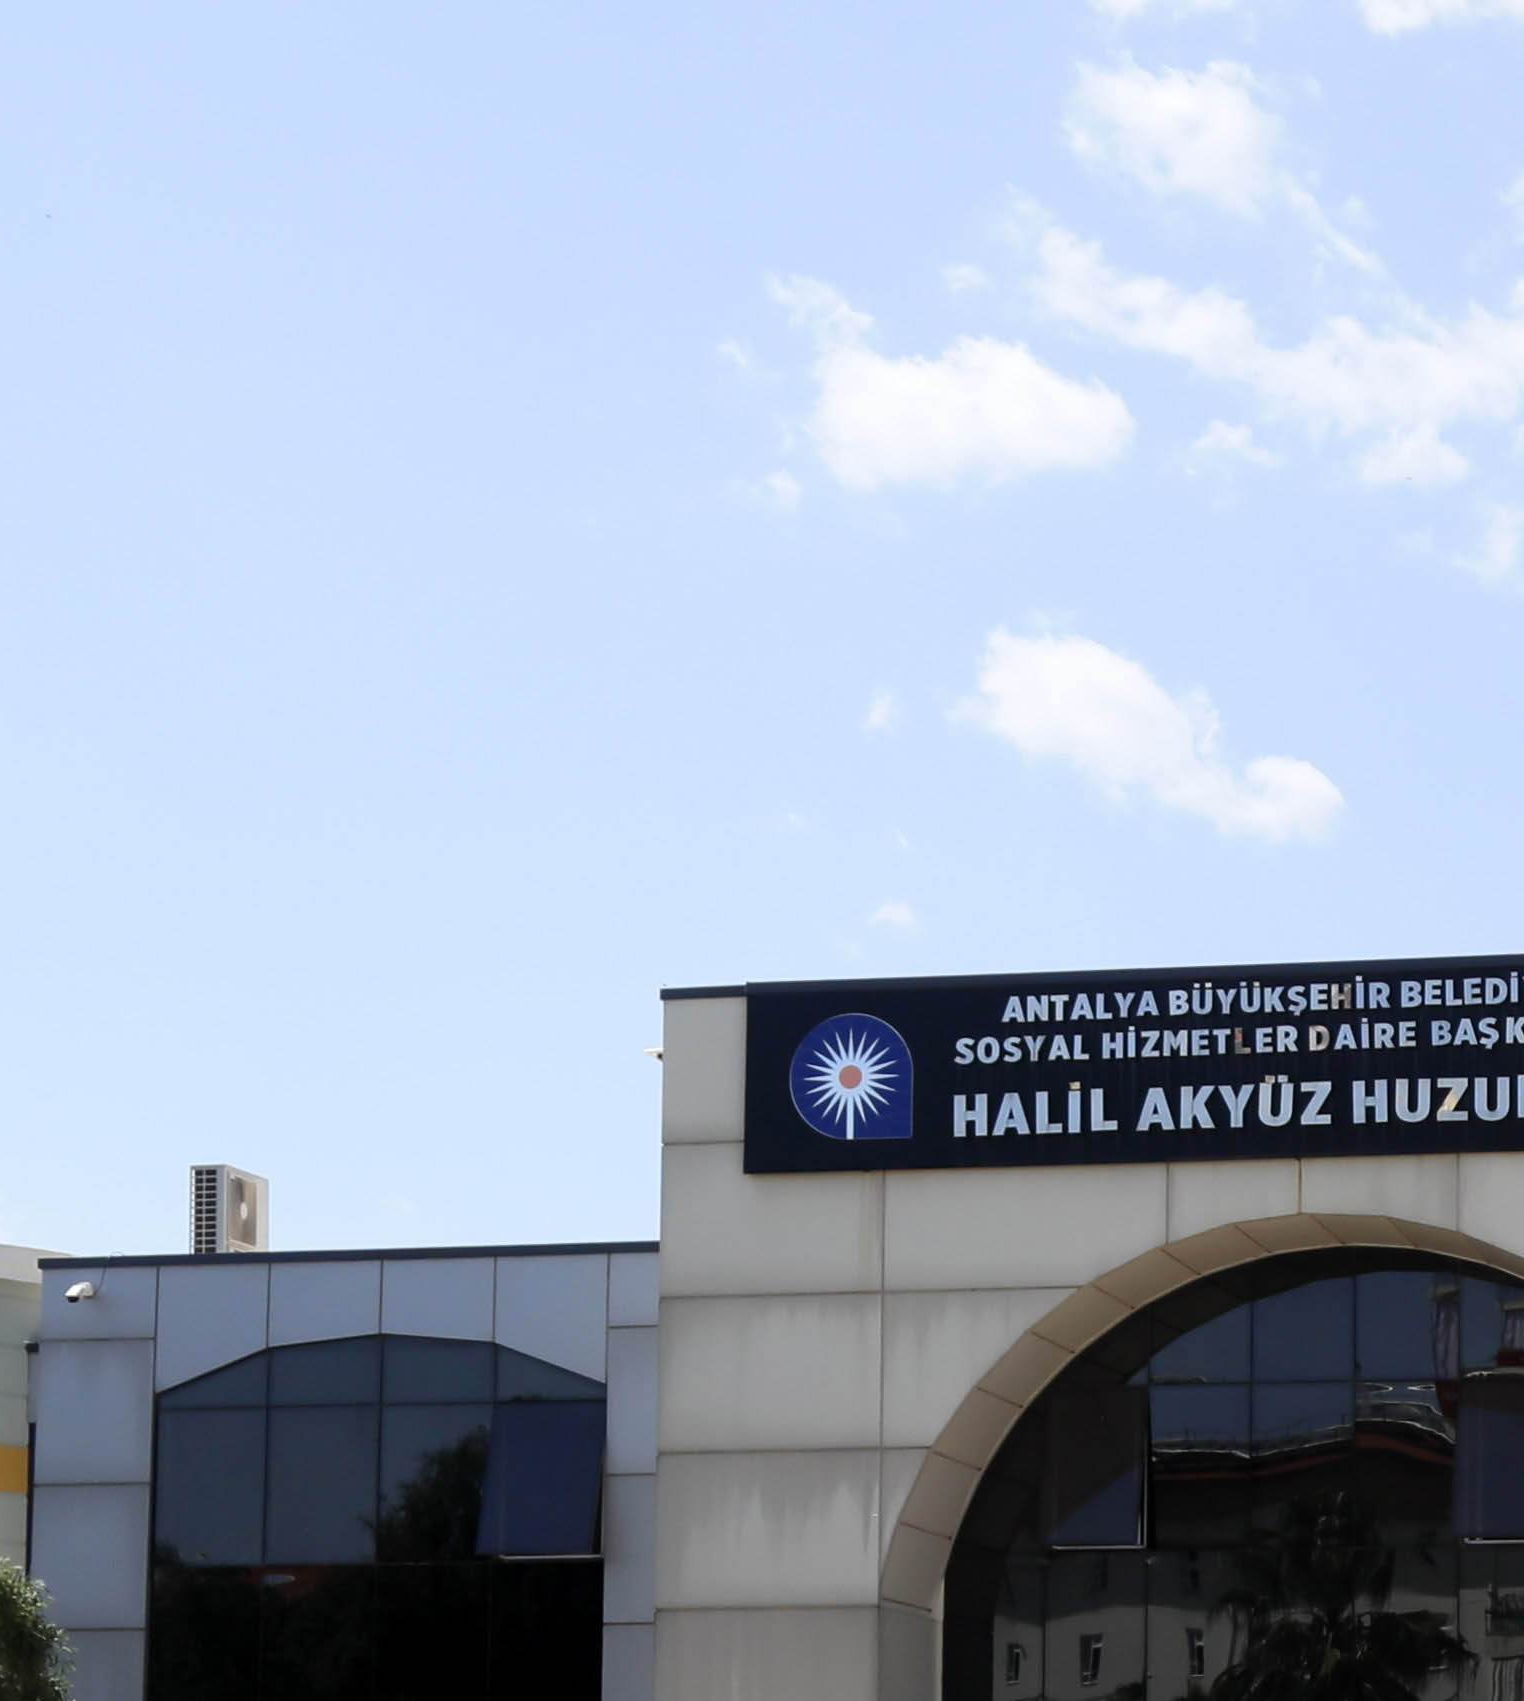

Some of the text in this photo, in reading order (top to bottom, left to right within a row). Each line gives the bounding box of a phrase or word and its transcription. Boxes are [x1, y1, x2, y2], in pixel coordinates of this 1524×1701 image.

[1002, 990, 1159, 1022] ANTALYA
[1169, 976, 1390, 1017] BÜYÜKŞEHİR
[954, 1034, 1090, 1065] SOSYAL
[1101, 1026, 1298, 1059] HİZMETLER
[1308, 1018, 1417, 1051] DAİRE
[953, 1081, 1118, 1137] HALİL
[1136, 1074, 1332, 1131] AKYÜZ
